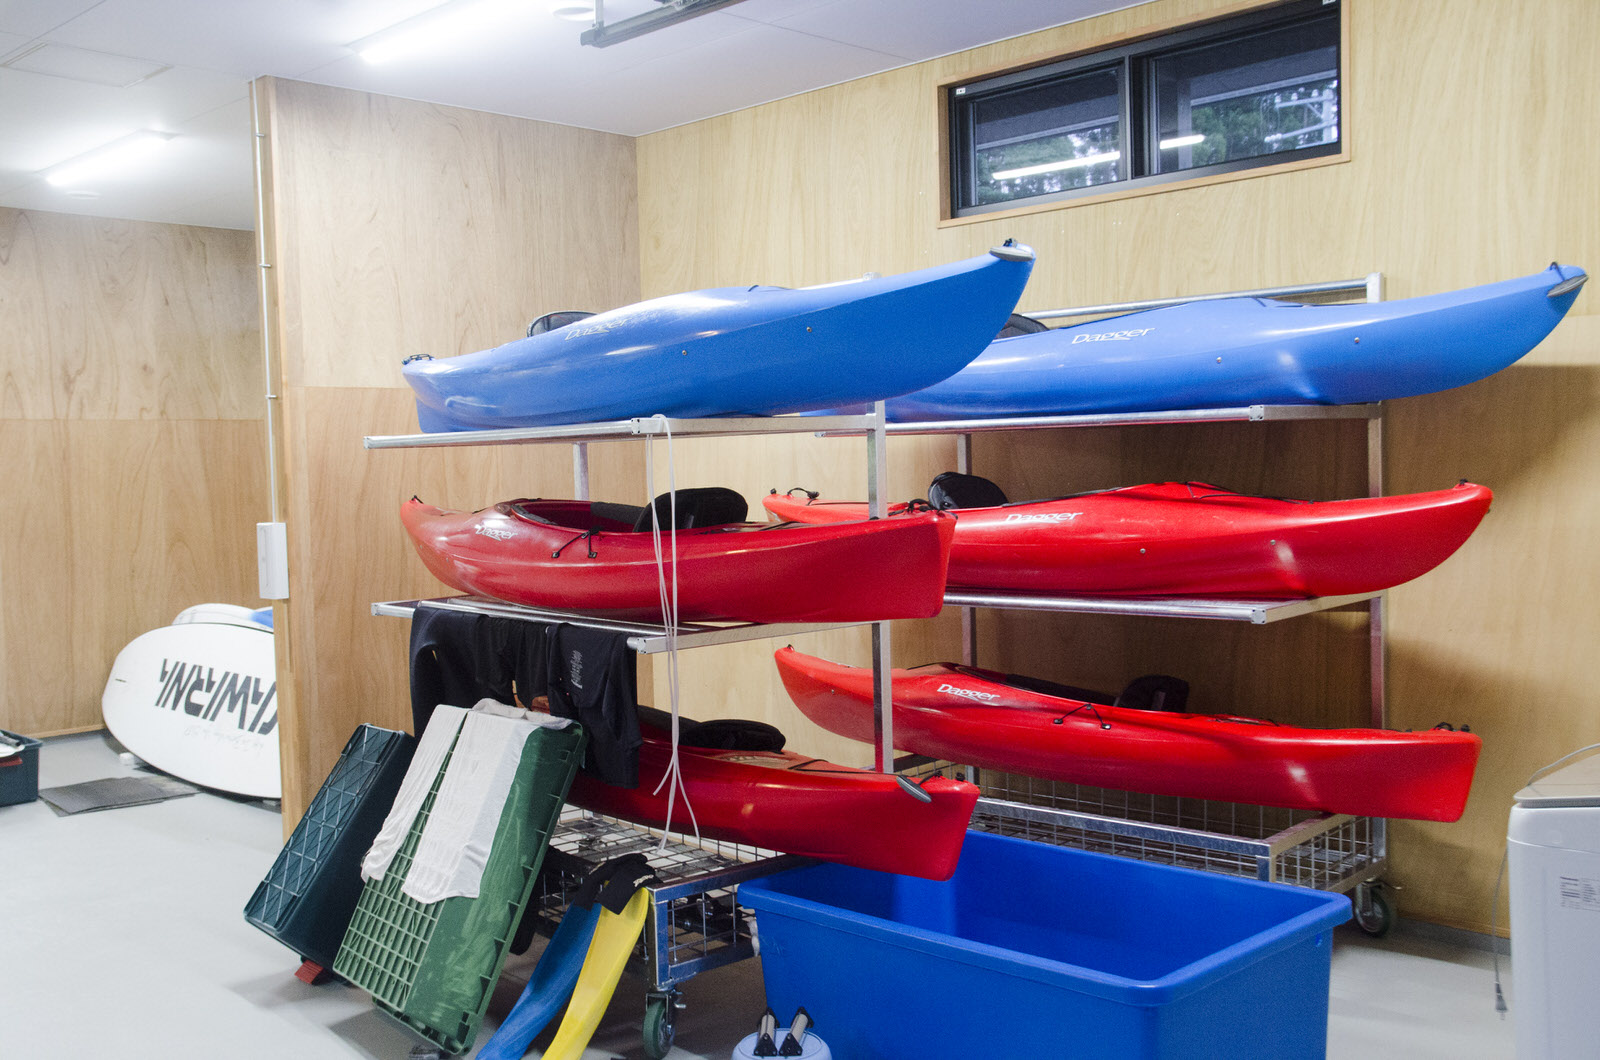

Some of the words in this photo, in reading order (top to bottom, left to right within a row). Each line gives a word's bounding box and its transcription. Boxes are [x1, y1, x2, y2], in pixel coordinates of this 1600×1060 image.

[1071, 327, 1156, 344] Dagger
[1005, 512, 1084, 524] Dagger
[475, 524, 518, 541] Dagger
[936, 683, 1001, 703] Dagger
